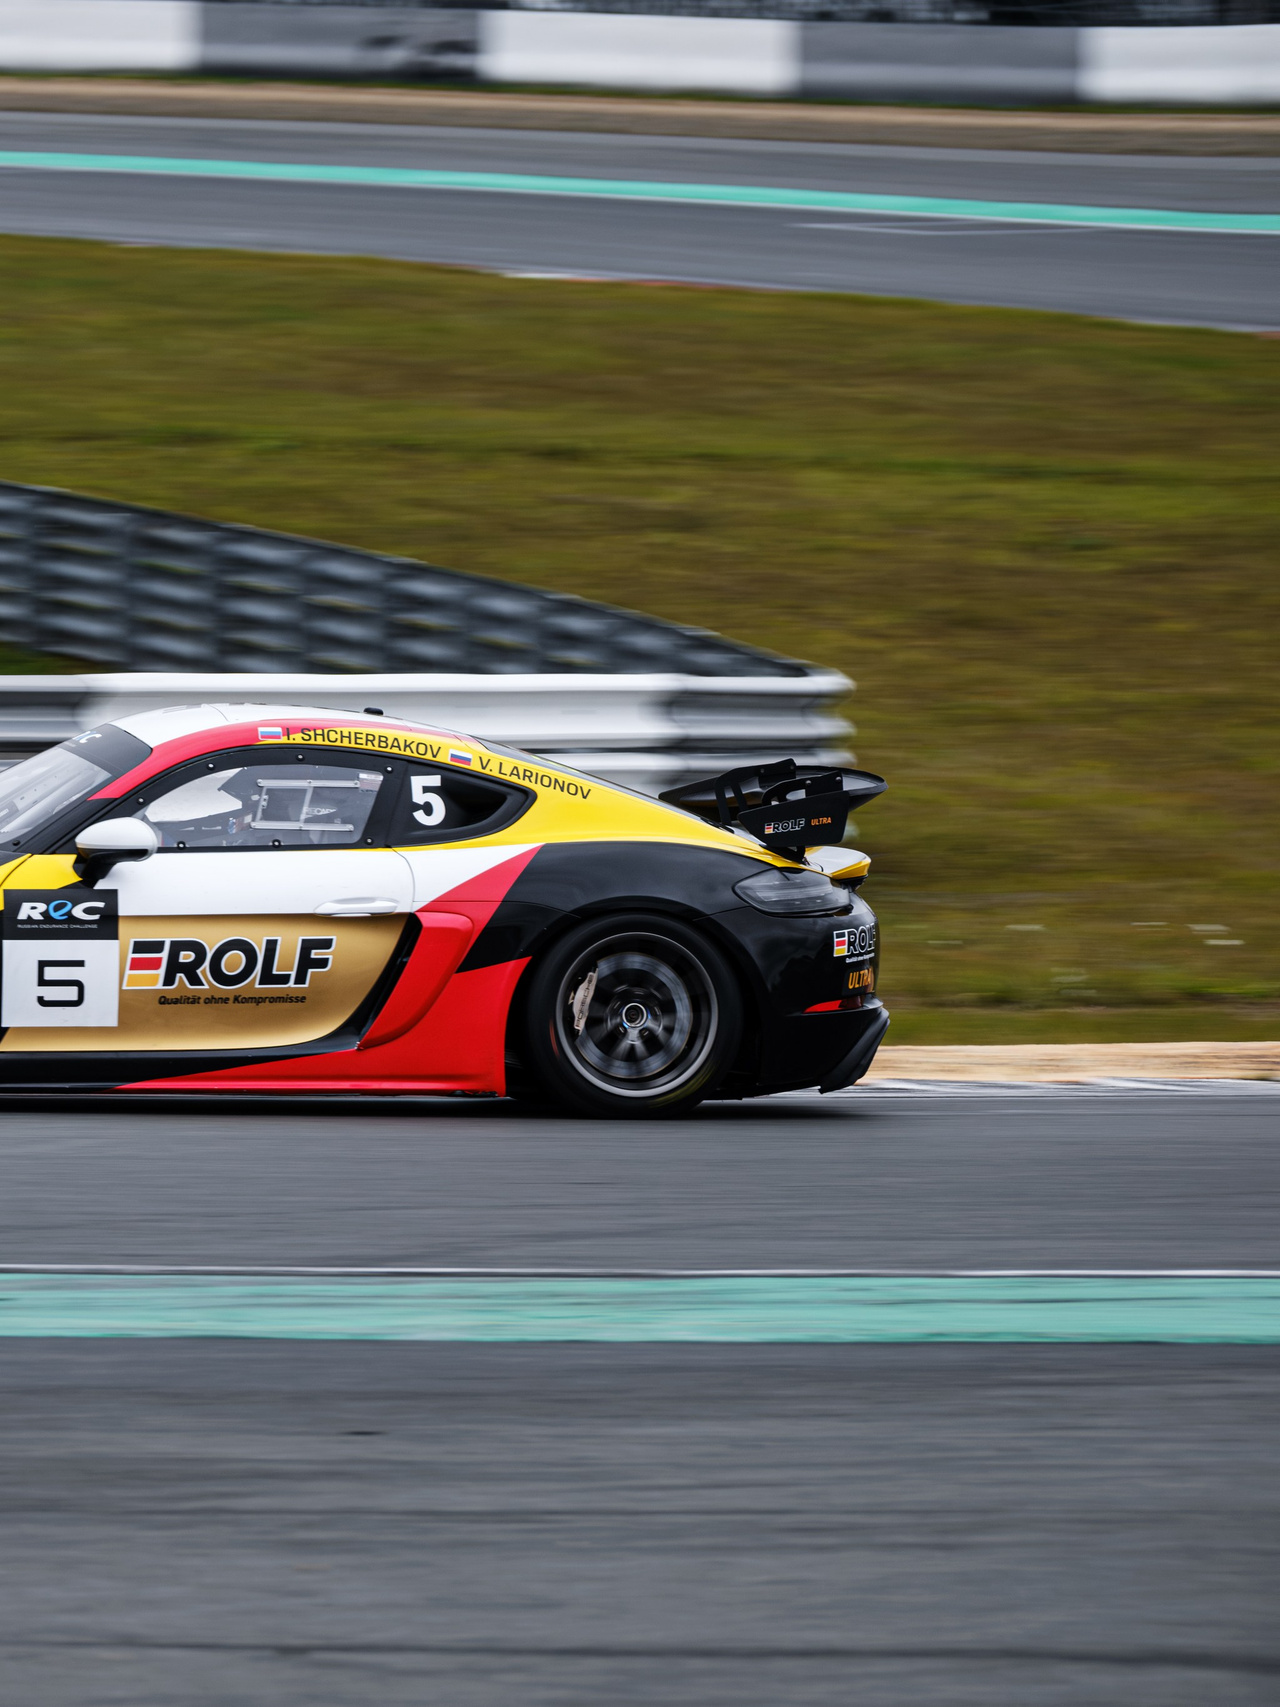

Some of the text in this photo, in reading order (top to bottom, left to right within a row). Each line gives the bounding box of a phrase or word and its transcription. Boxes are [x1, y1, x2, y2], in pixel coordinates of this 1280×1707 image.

[286, 727, 442, 759] I. SHCHERBAKOV
[478, 756, 592, 800] V. LARIONOV
[410, 774, 446, 826] 5
[772, 816, 832, 833] ROLF ULTRA
[160, 936, 337, 989] ROLF
[847, 967, 874, 990] ULTRA
[36, 959, 86, 1008] 5
[158, 993, 307, 1006] Qualität ohne Kompromisse
